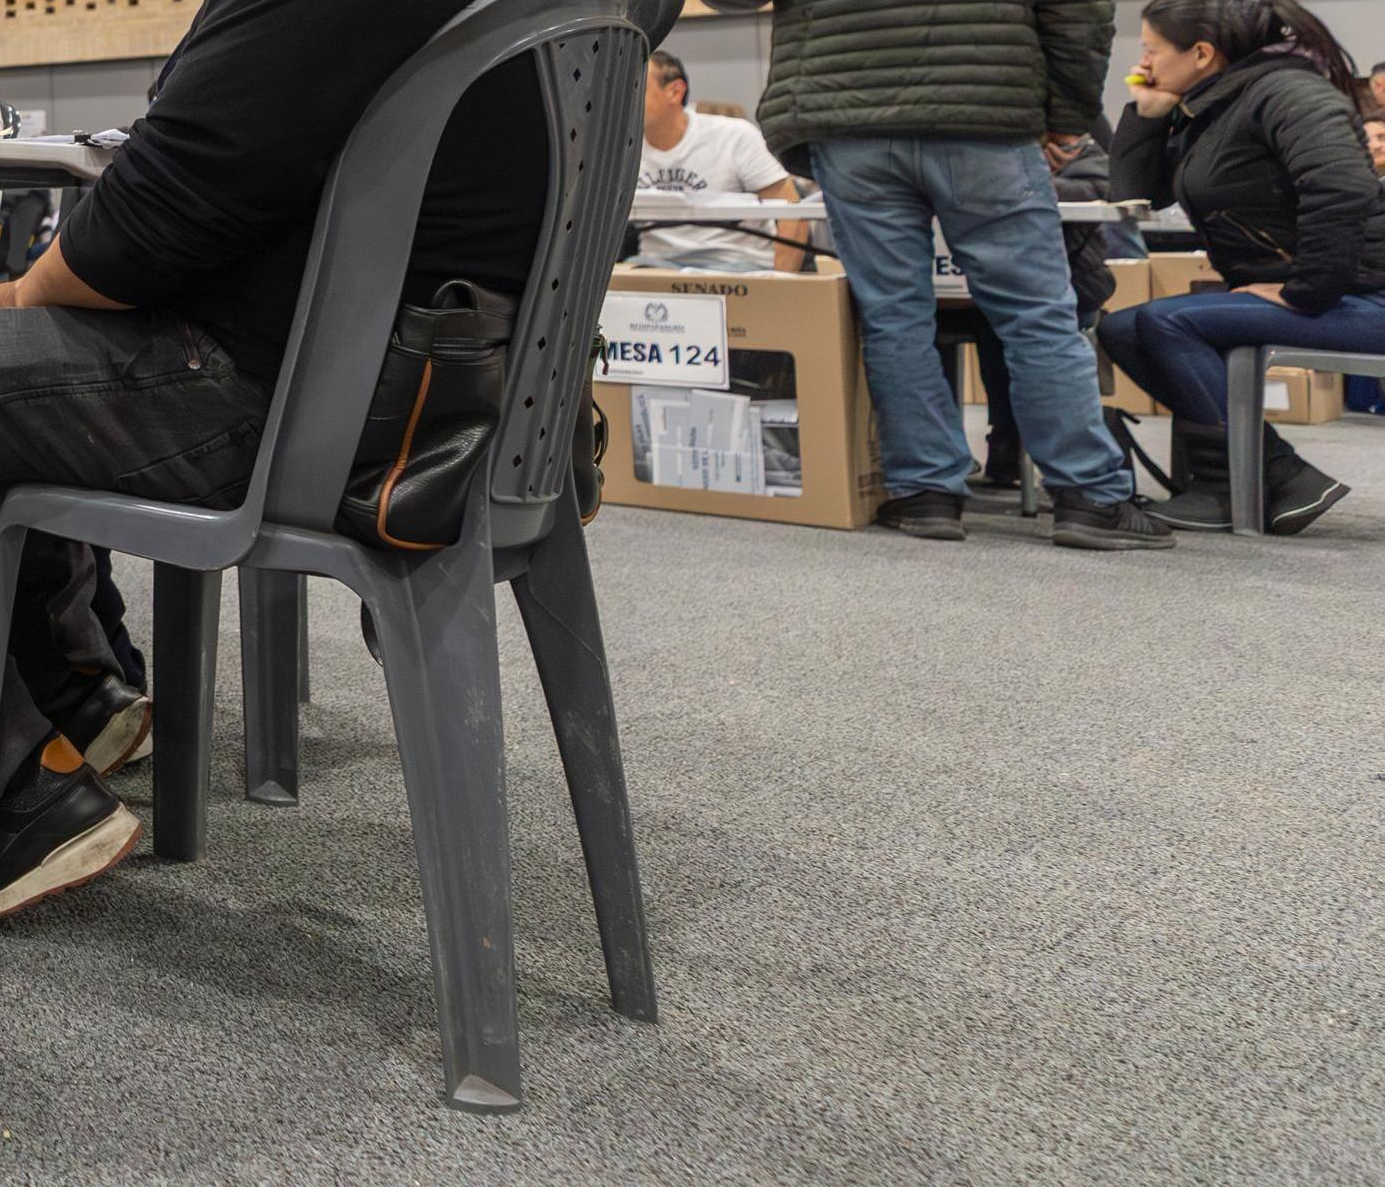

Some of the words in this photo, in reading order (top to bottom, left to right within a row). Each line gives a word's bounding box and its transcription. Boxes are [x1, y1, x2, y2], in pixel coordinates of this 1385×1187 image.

[638, 168, 708, 190] ILFIGER
[671, 282, 749, 297] SENADO
[601, 341, 663, 364] MESA
[669, 345, 721, 367] 124
